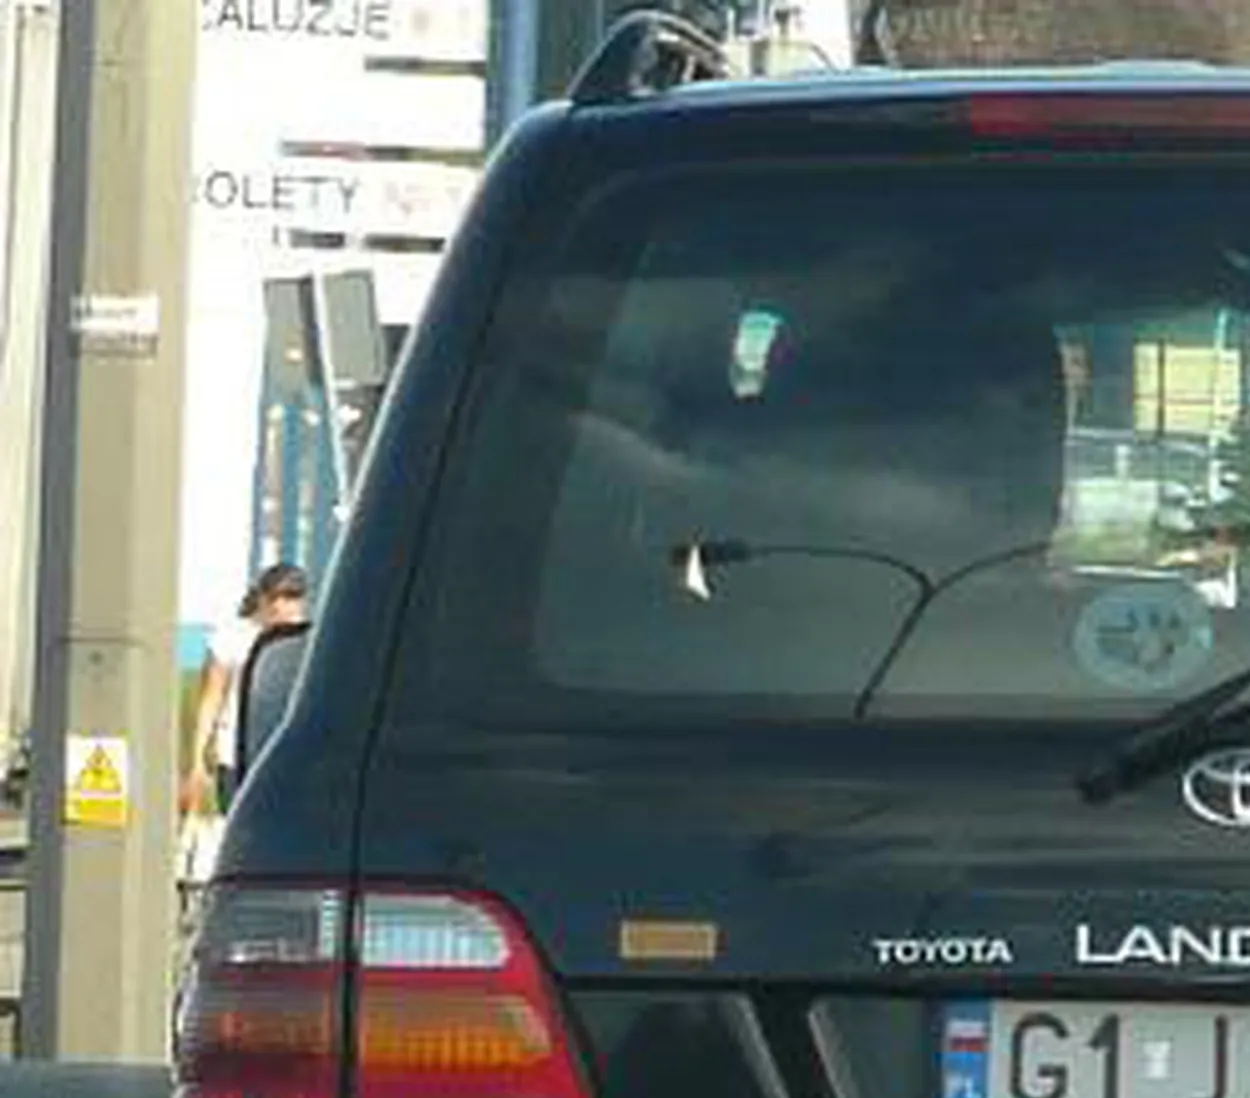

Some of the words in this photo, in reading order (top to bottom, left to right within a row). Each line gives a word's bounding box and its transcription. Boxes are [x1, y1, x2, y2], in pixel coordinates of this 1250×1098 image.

[202, 0, 391, 40] ALUZJE
[192, 170, 360, 213] OLETY
[873, 938, 1013, 965] TOYOTA
